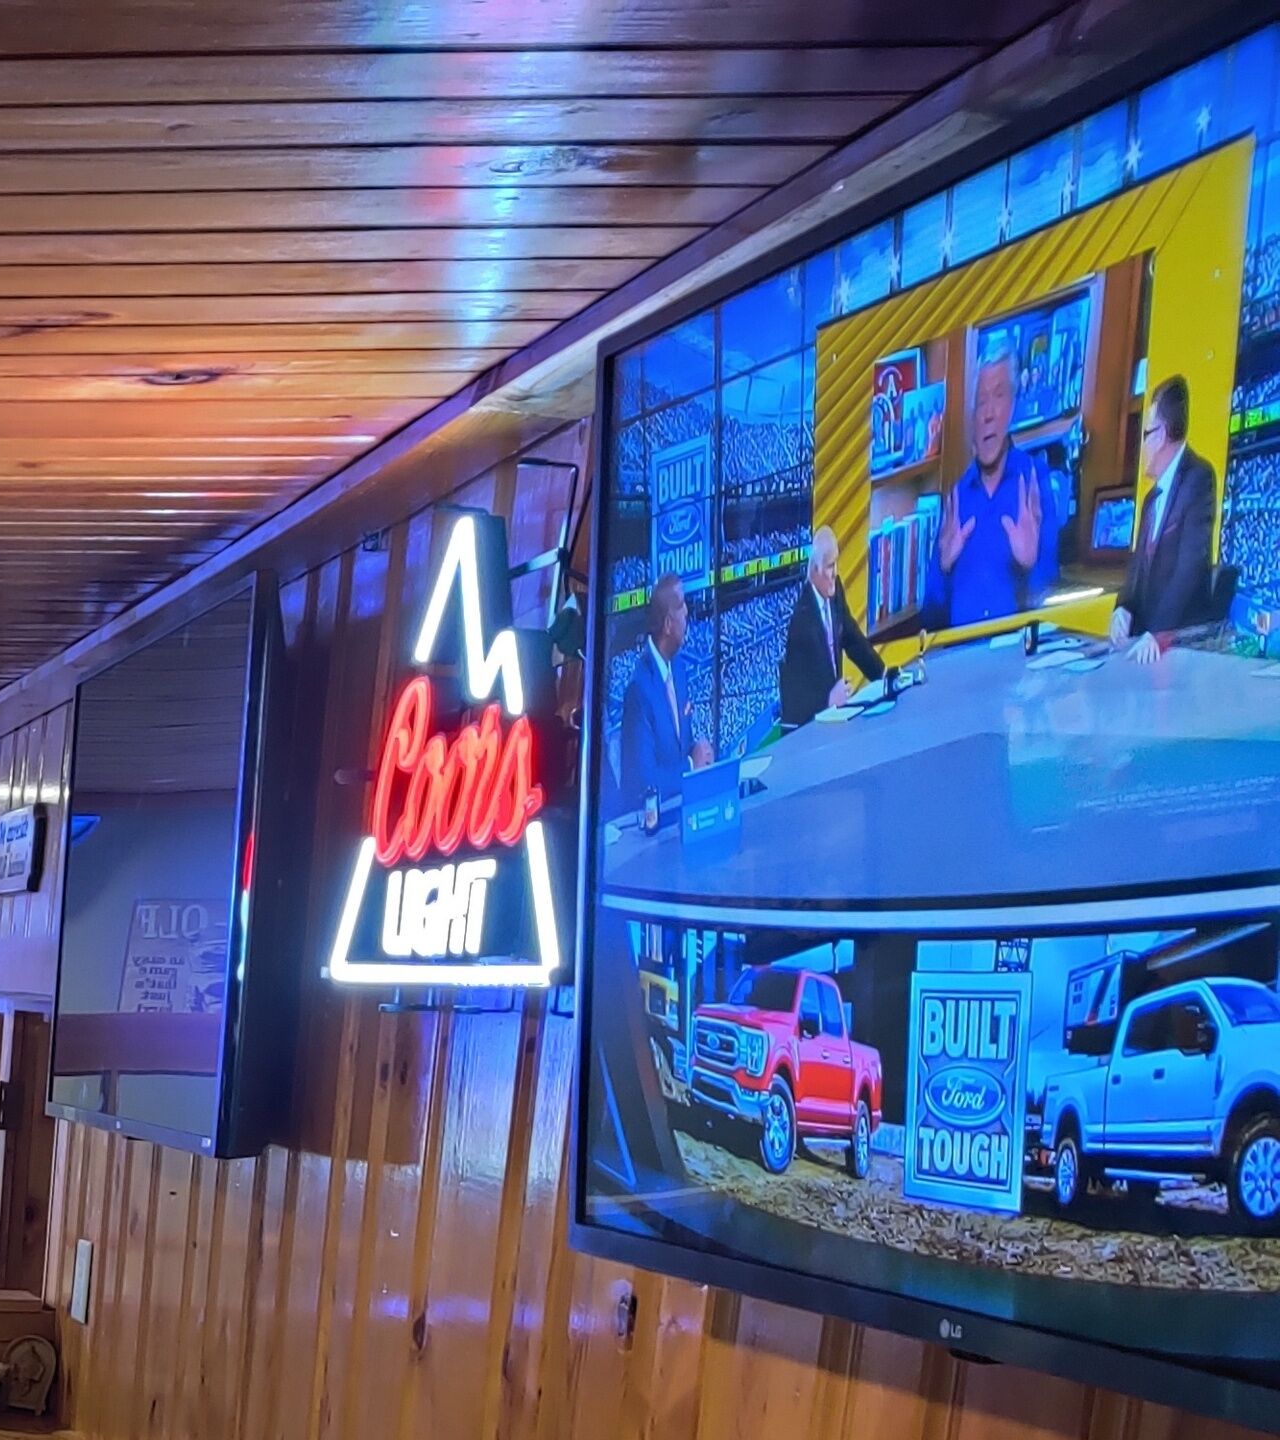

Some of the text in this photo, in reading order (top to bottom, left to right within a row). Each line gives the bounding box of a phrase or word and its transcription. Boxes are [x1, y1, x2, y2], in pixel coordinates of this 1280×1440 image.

[658, 453, 704, 505] BUILT
[658, 540, 703, 576] TOUGH
[374, 675, 544, 867] Coors
[383, 858, 497, 956] LIGHT
[922, 998, 1017, 1060] BUILT
[942, 1075, 986, 1110] Ford
[918, 1126, 1009, 1181] TOUGH
[951, 1322, 962, 1338] LG
